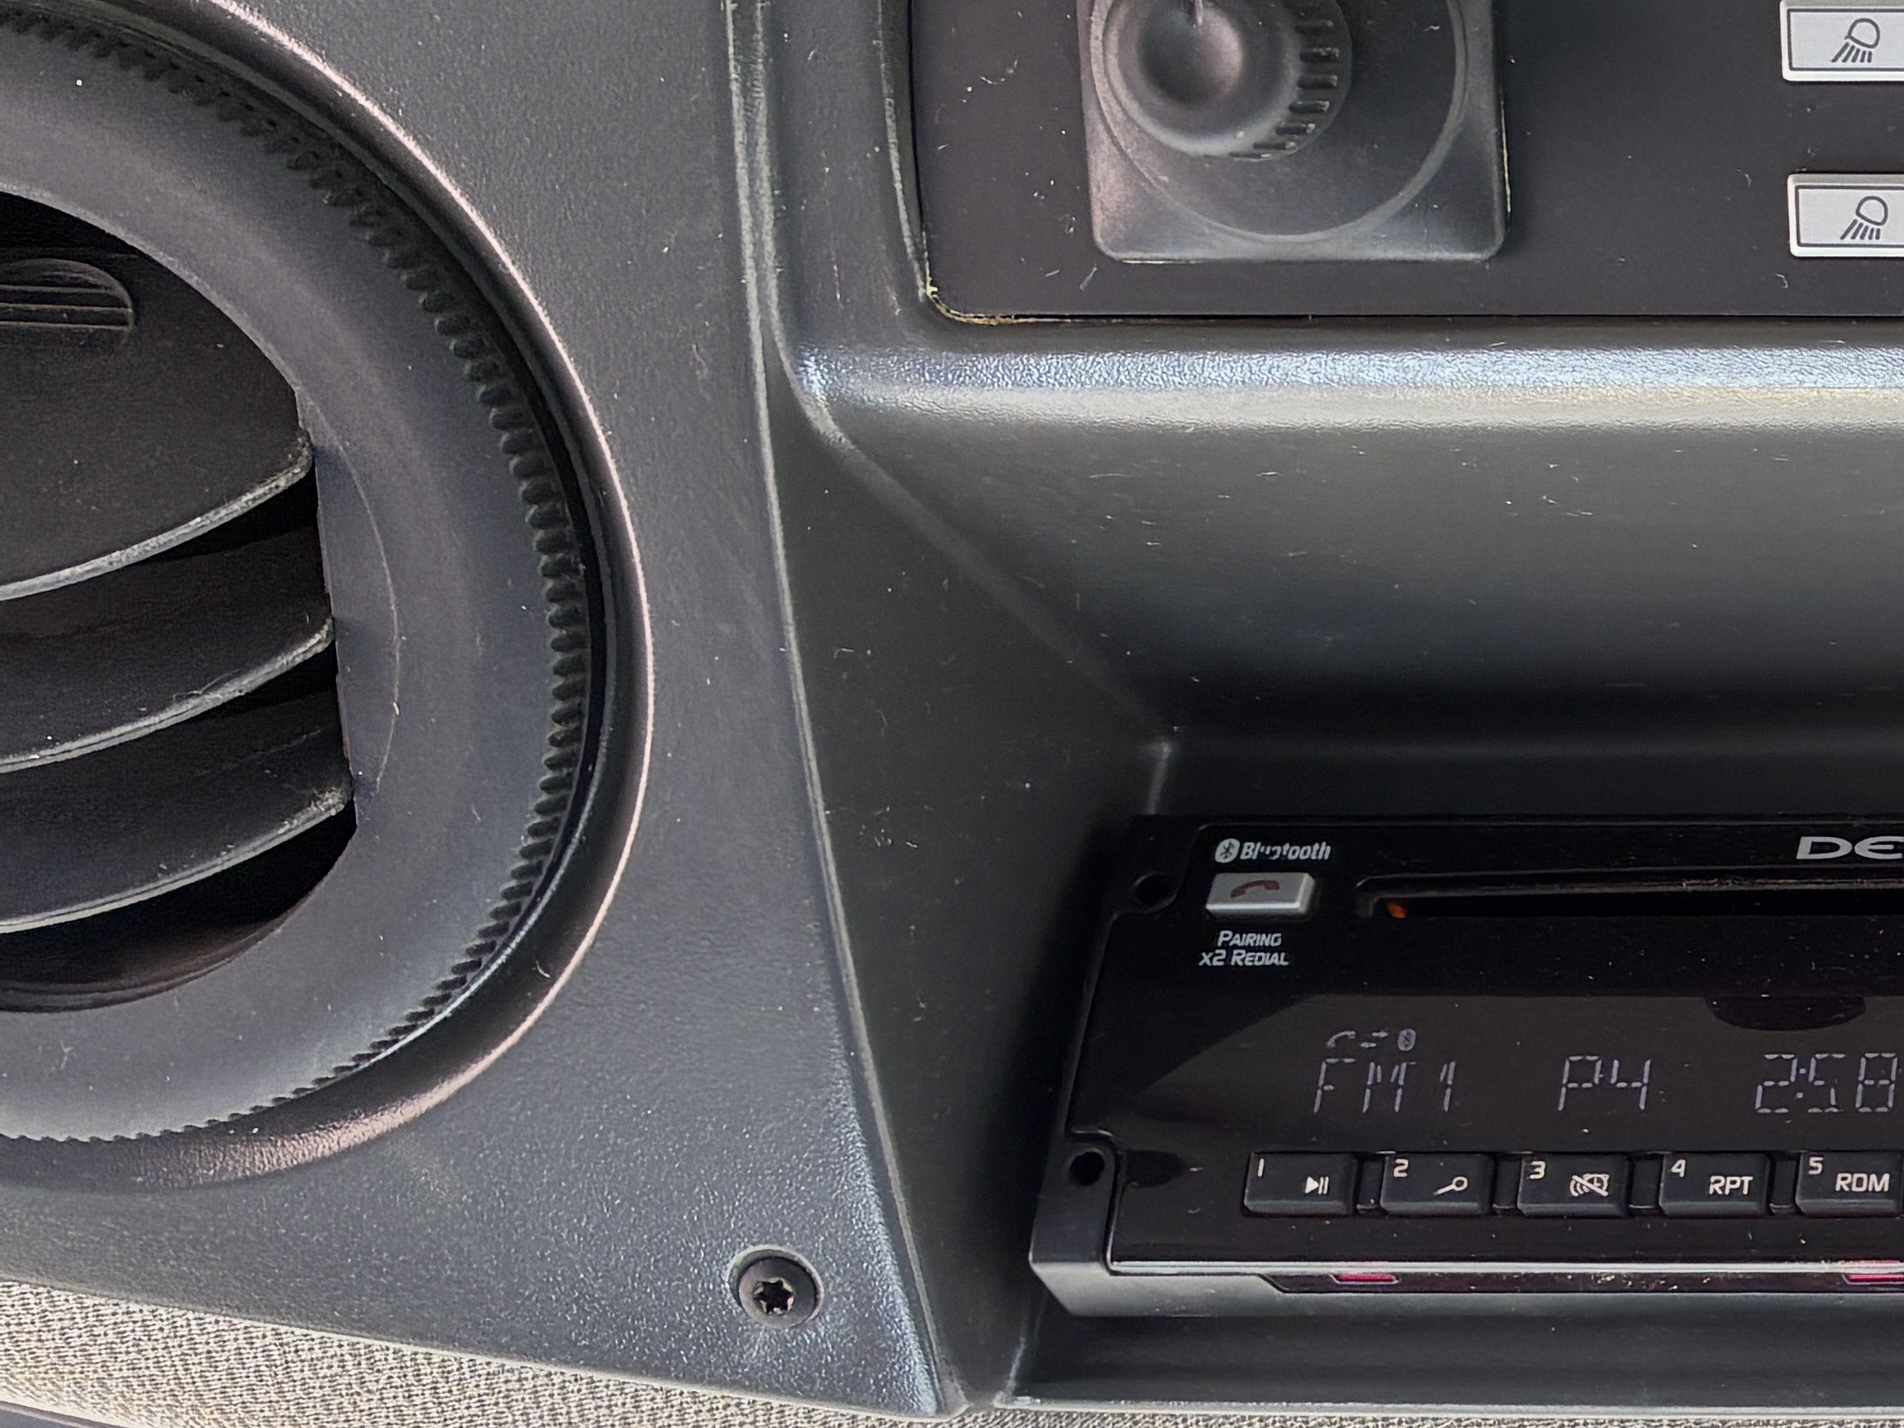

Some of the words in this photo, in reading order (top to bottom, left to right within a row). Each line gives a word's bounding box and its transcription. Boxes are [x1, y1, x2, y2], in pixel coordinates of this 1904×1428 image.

[1557, 1054, 1652, 1112] P4
[1256, 1158, 1266, 1177] 1
[1392, 1158, 1410, 1179] 2
[1528, 1159, 1547, 1180] 3
[1669, 1158, 1687, 1179] 4
[1807, 1155, 1825, 1176] 5
[1708, 1175, 1755, 1196] RPT
[1834, 1172, 1891, 1193] RDM
